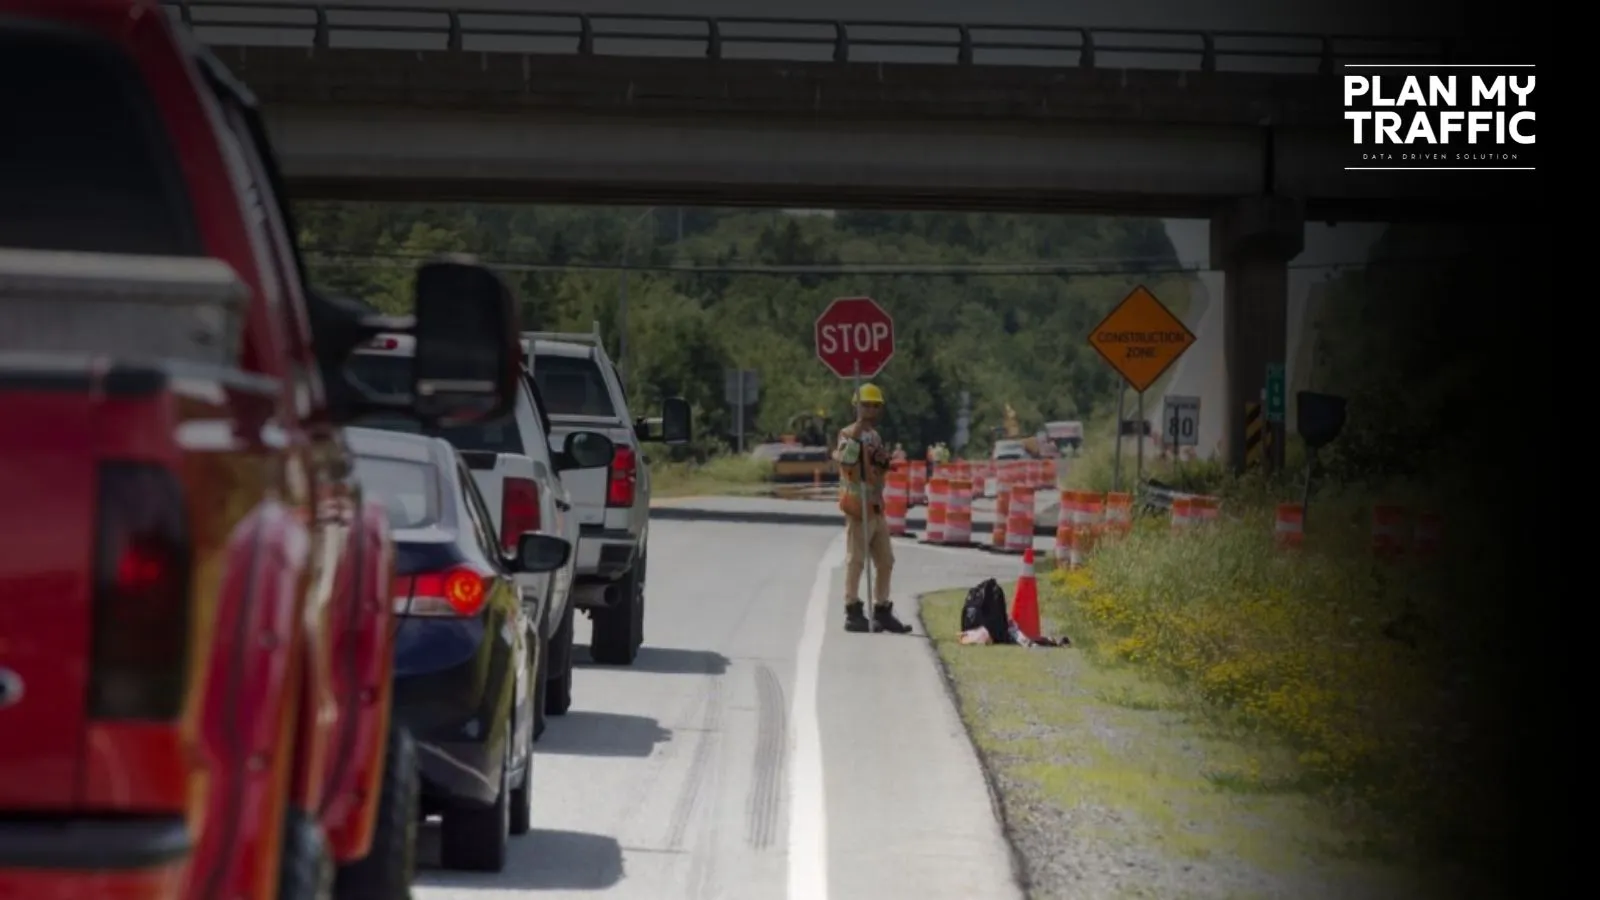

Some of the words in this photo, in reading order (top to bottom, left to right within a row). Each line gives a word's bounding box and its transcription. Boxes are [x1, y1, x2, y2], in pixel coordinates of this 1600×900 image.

[820, 321, 889, 354] STOP
[1096, 331, 1186, 344] CONSTRUCTION
[1125, 346, 1157, 359] ZONE
[1168, 416, 1194, 438] 80
